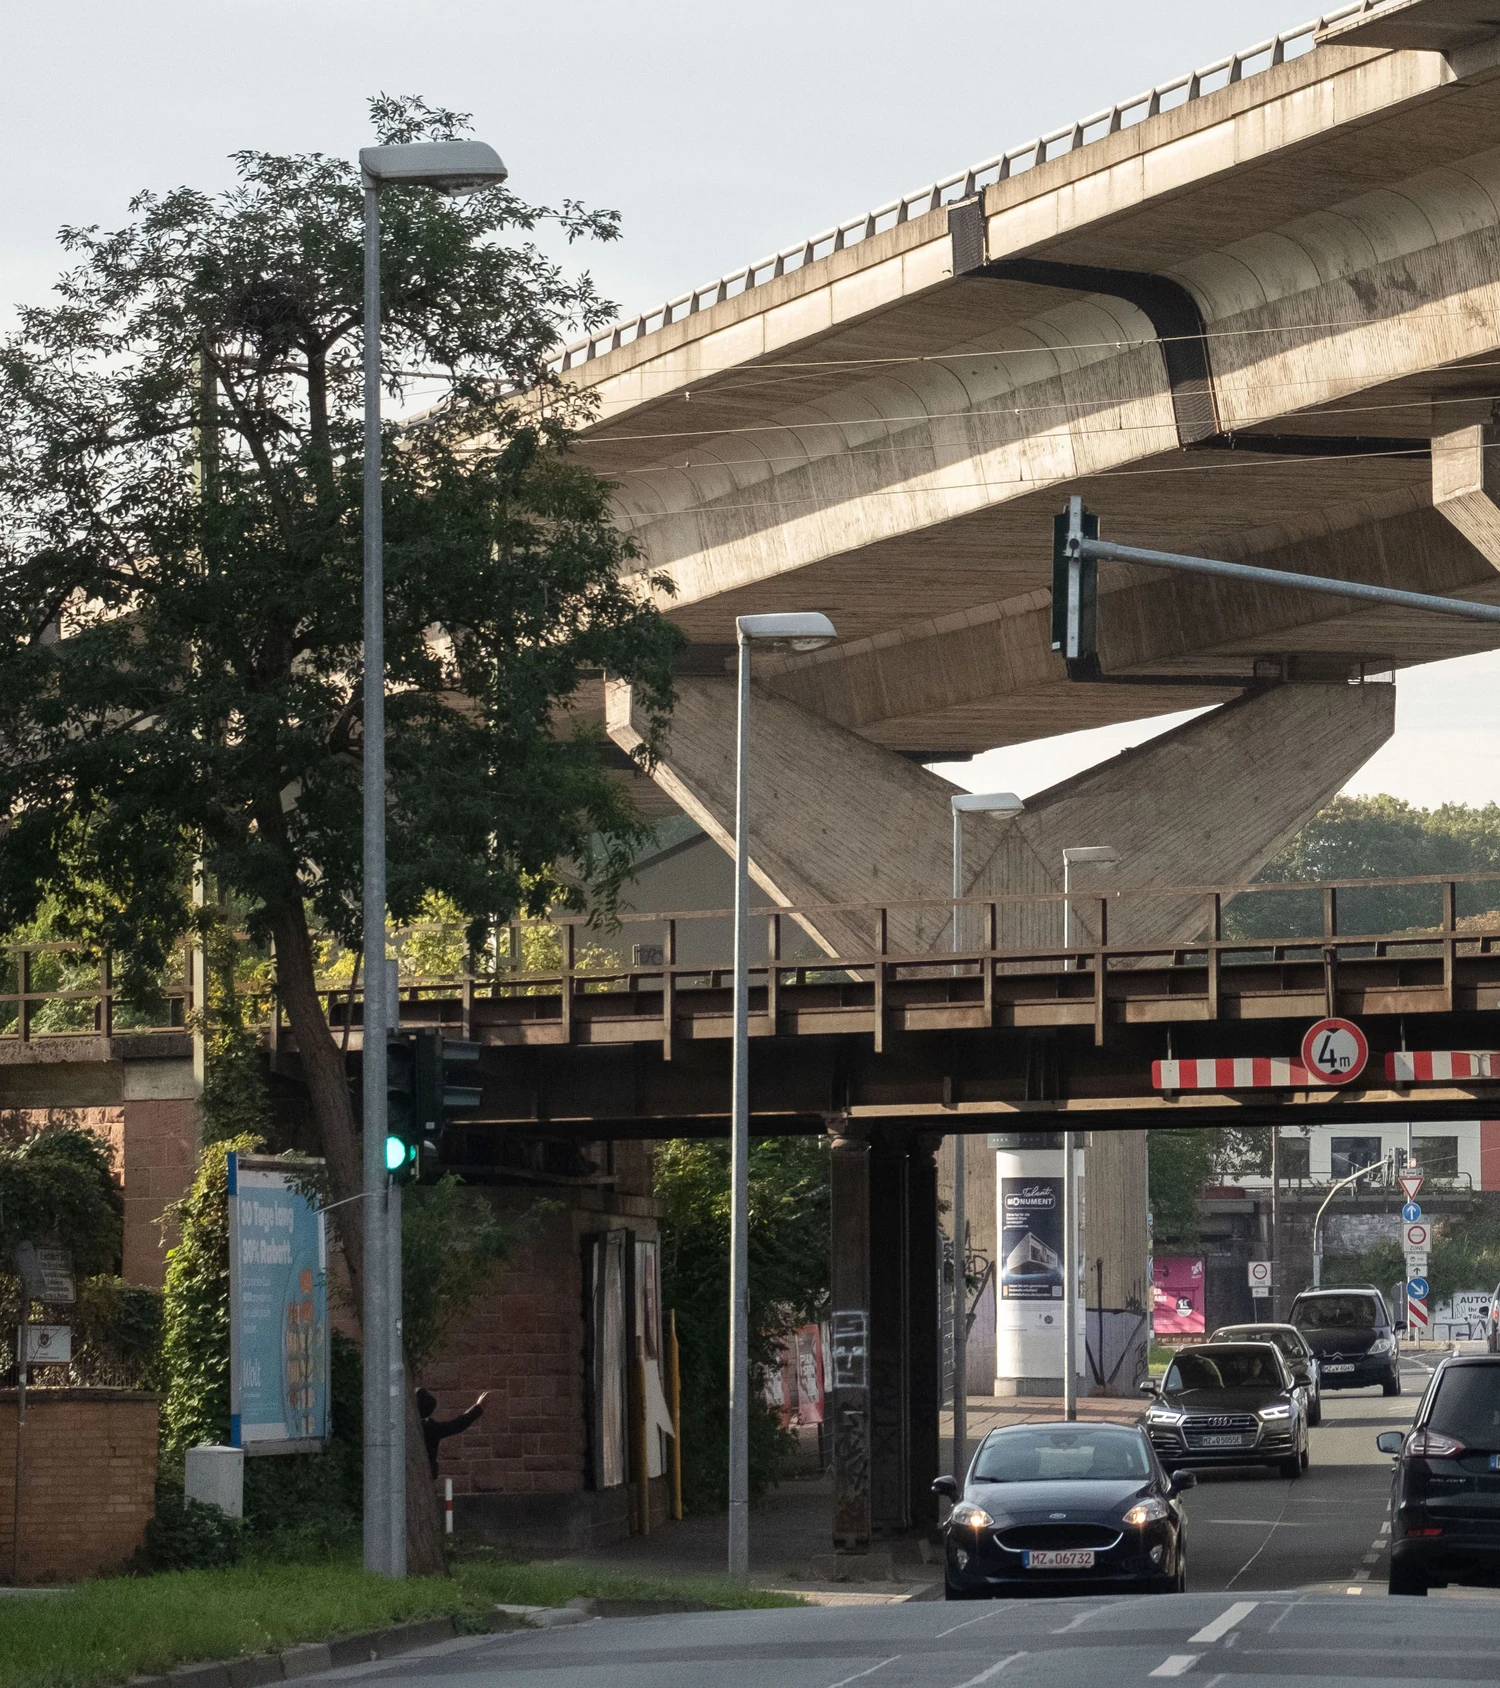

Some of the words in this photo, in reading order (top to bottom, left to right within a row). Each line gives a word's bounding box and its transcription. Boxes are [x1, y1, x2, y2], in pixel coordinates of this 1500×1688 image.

[1022, 1185, 1052, 1197] Talent
[1007, 1197, 1053, 1206] MONUMENT
[1031, 1552, 1047, 1565] MZ
[1055, 1552, 1092, 1565] 06732
